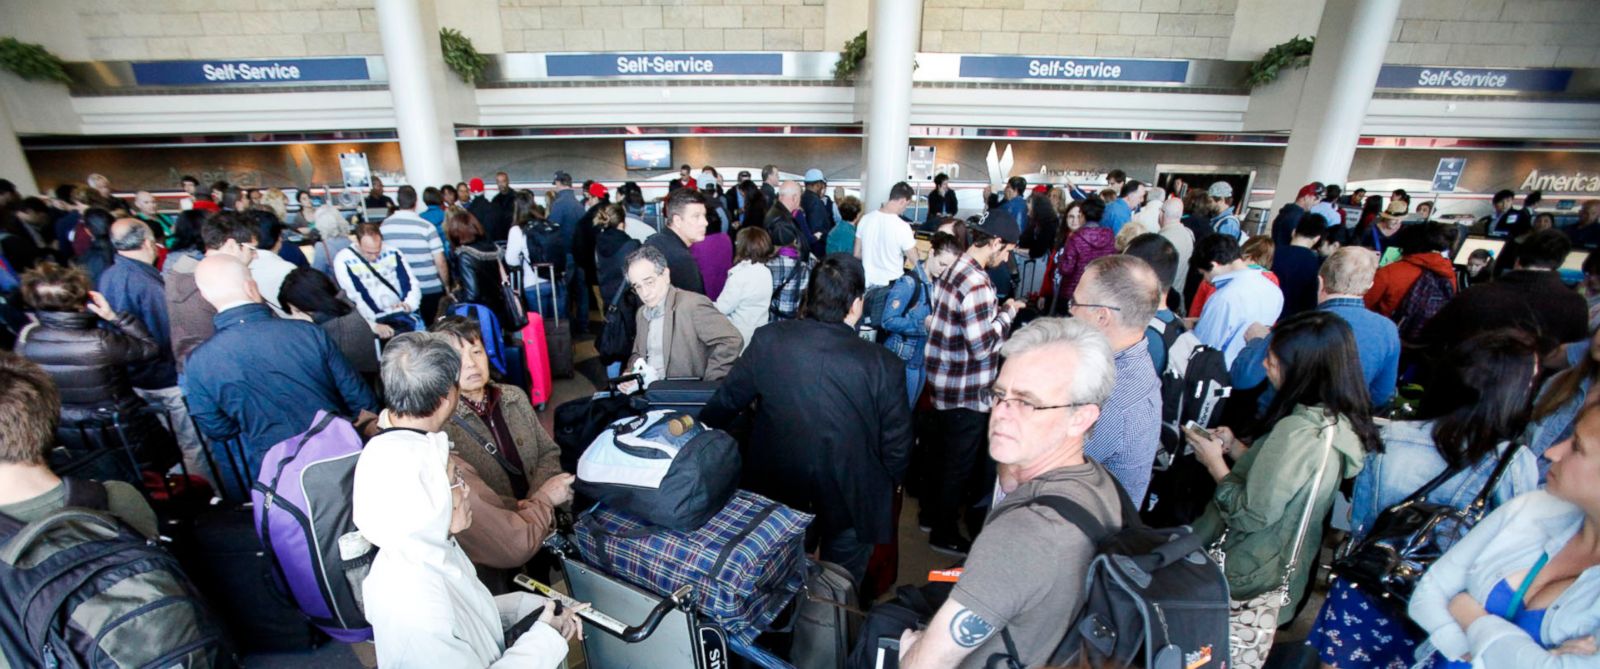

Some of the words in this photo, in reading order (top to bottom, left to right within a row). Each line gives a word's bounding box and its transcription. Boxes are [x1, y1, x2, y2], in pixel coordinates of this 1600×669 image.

[203, 63, 300, 80] Self-Service
[616, 56, 714, 73] Self-Service
[1028, 60, 1121, 78] Self-Service
[1418, 70, 1507, 87] Self-Service
